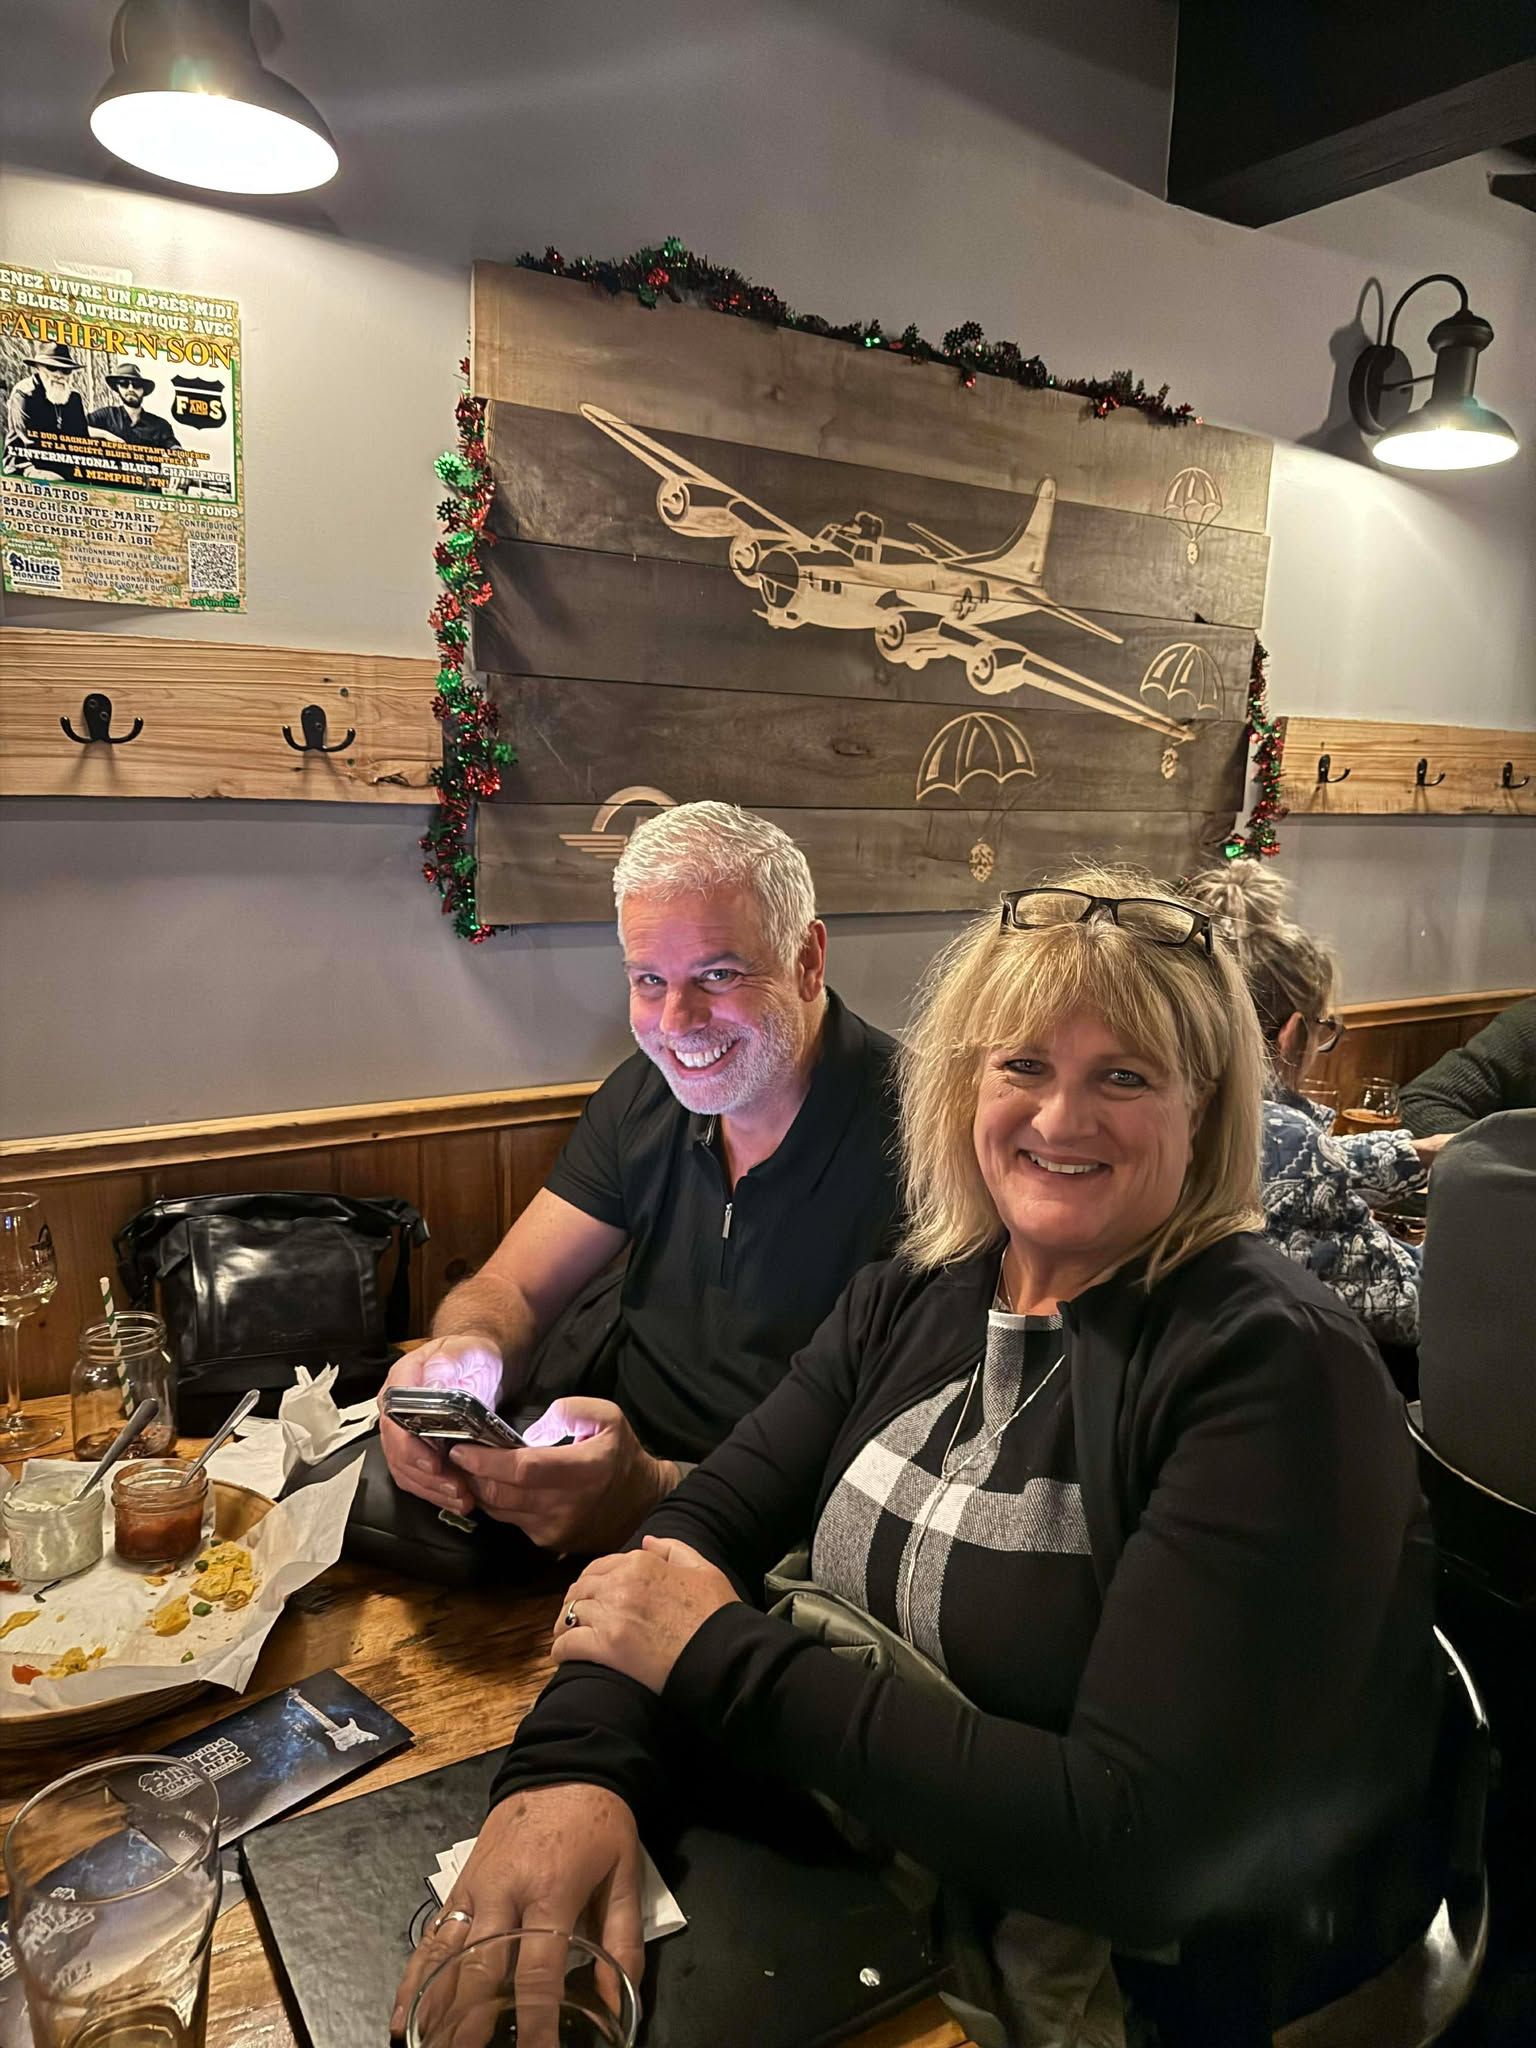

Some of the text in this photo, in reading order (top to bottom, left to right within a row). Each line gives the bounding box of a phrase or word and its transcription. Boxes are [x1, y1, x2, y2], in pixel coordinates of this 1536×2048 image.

[0, 269, 233, 320] ENEZ VIVRE UN APRÈS-MIDI
[16, 290, 70, 312] BLUES
[75, 300, 189, 331] AUTHENTIQUE
[194, 320, 233, 337] AVEC
[0, 310, 232, 370] FATHER N SON
[27, 429, 39, 438] LE
[40, 432, 57, 441] DUO
[59, 435, 100, 447] GAGNANT
[167, 448, 177, 457] LE
[41, 441, 53, 449] ET
[54, 442, 66, 451] LA
[105, 449, 131, 460] BLUES
[133, 452, 144, 461] DE
[8, 445, 230, 483] L'INTERNATIONAL BLUES CHALLENGE
[73, 466, 83, 478] À
[86, 469, 146, 486] MEMPHIS,
[2, 481, 88, 502] L'ALBATROS
[3, 496, 155, 523] 2928 CH SAINTE-MARIE
[135, 498, 239, 518] LEVÉE DE FONDS
[4, 507, 159, 533] MASCOUCHE, QC J7K 1N7
[179, 519, 238, 531] CONTRIBUTION
[5, 521, 12, 529] 7
[18, 522, 86, 539] DECEMBRE
[91, 532, 113, 543] 16H
[131, 536, 153, 546] 18H
[190, 531, 238, 542] VOLONTAIRE
[70, 546, 179, 563] STATIONNEMENT VIA RUE DUPRAS
[11, 556, 60, 576] Blues
[103, 558, 130, 567] GAUCHE
[132, 561, 139, 569] DE
[151, 563, 180, 572] CASERNE
[83, 578, 108, 586] FONDS
[120, 581, 148, 590] VOYAGE
[84, 571, 104, 579] TOUS
[121, 574, 140, 582] DONS
